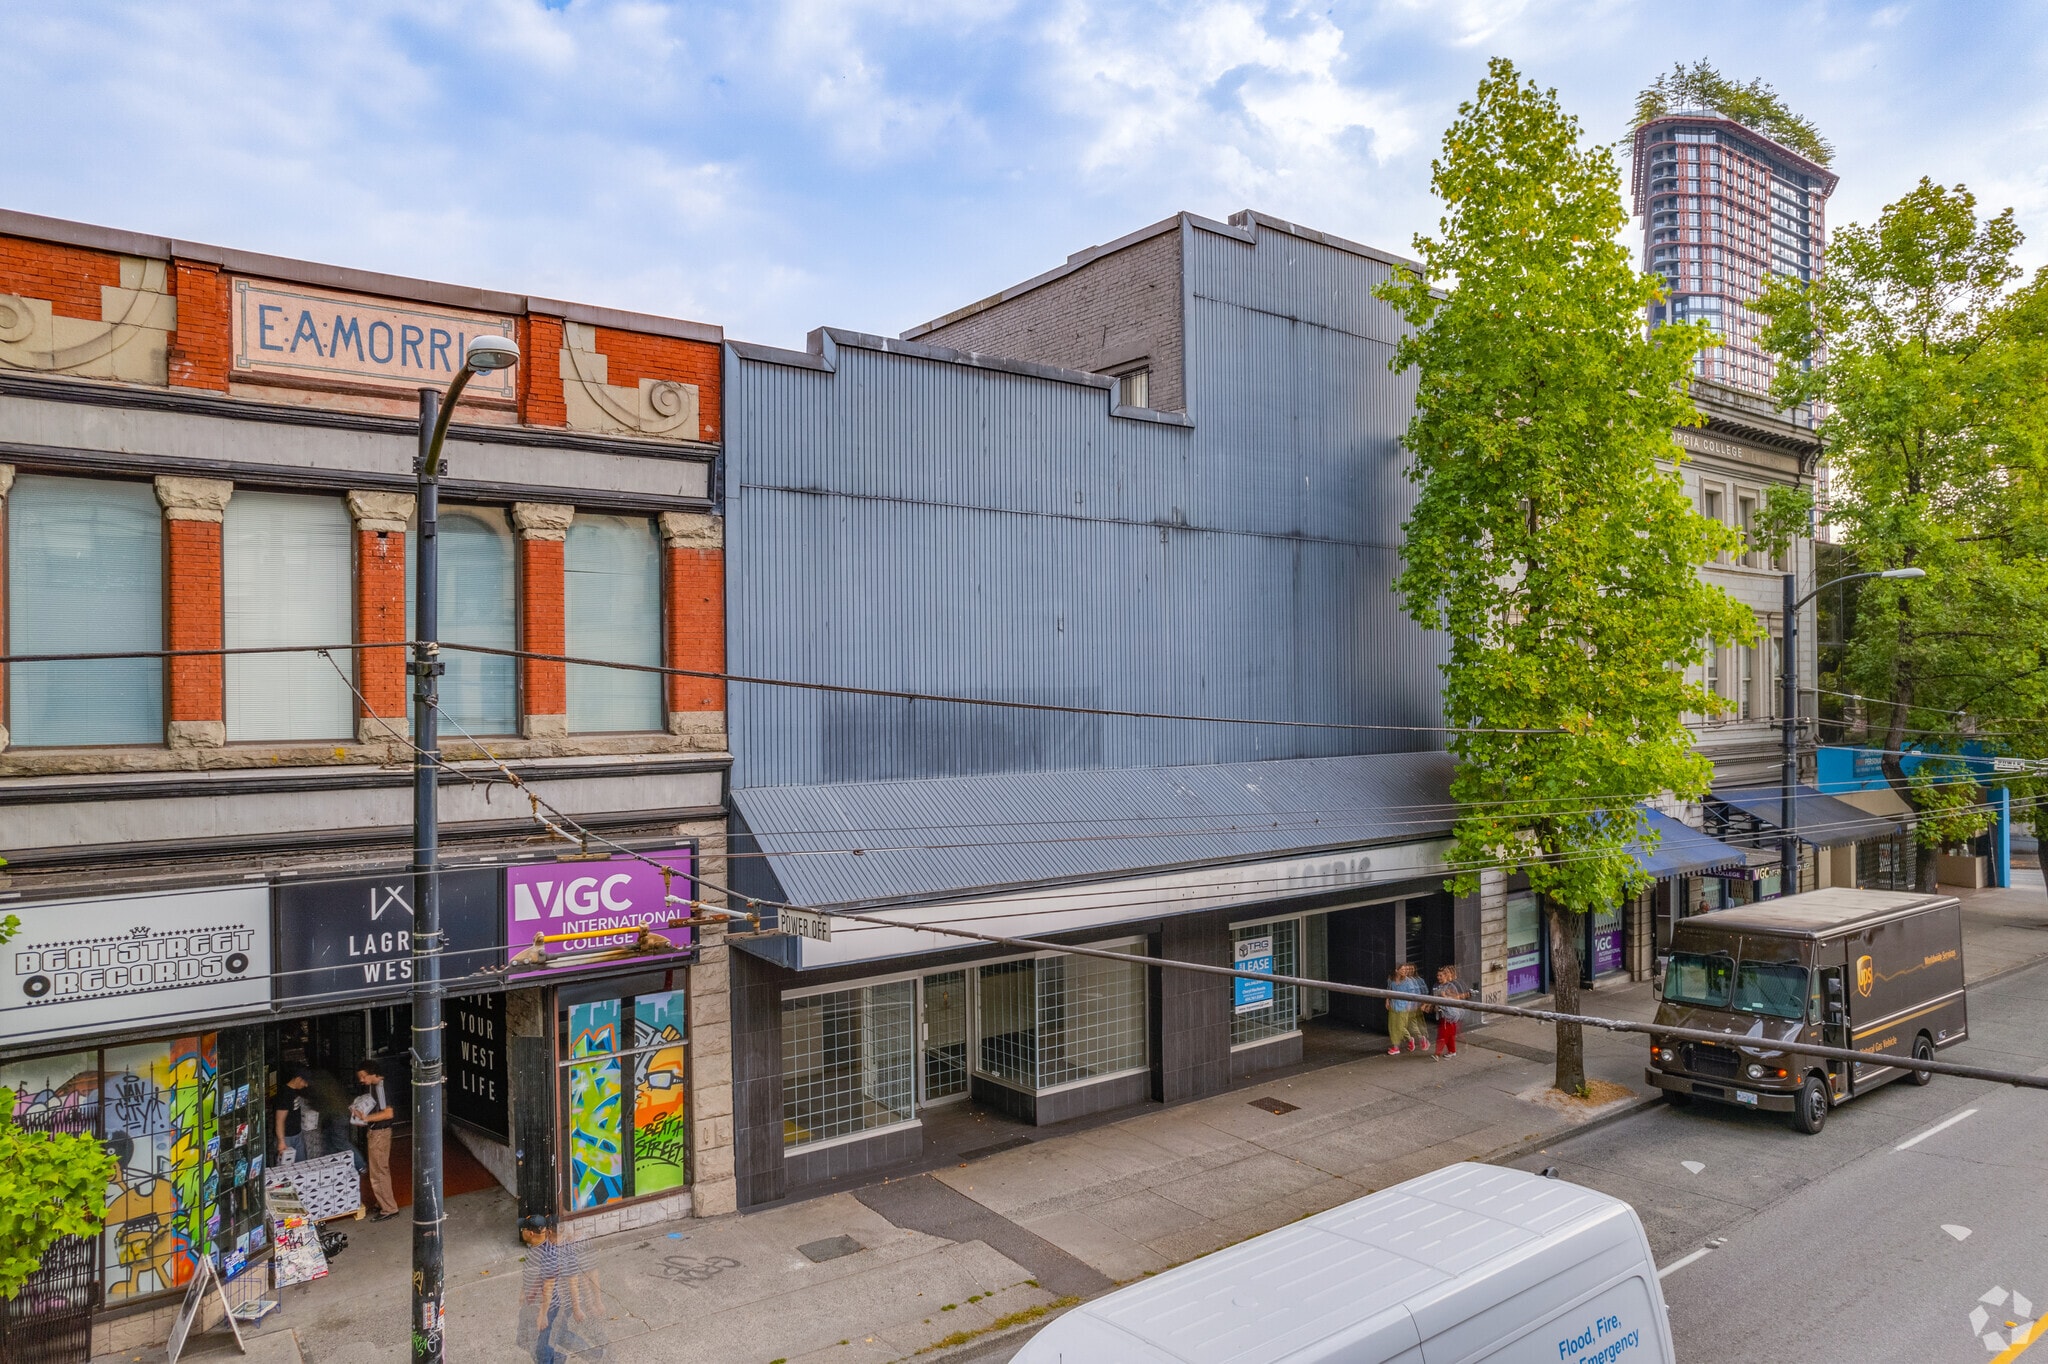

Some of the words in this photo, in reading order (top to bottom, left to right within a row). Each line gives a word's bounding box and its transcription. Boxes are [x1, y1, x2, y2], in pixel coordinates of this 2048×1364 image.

[1703, 439, 1743, 458] COLLEGE
[1754, 866, 1769, 880] VGC
[515, 873, 633, 921] VGC
[781, 914, 808, 937] POWER
[811, 920, 827, 941] OFF
[349, 930, 410, 957] LAGR
[563, 932, 634, 951] COLLEGE
[54, 956, 223, 995] RECORDS
[363, 959, 412, 984] WES
[1243, 958, 1270, 972] LEASE
[460, 1010, 494, 1040] YOUR
[461, 1041, 494, 1070] WEST
[115, 1081, 145, 1103] VAN
[1558, 1326, 1596, 1360] Flood,
[1595, 1314, 1622, 1338] Fire,
